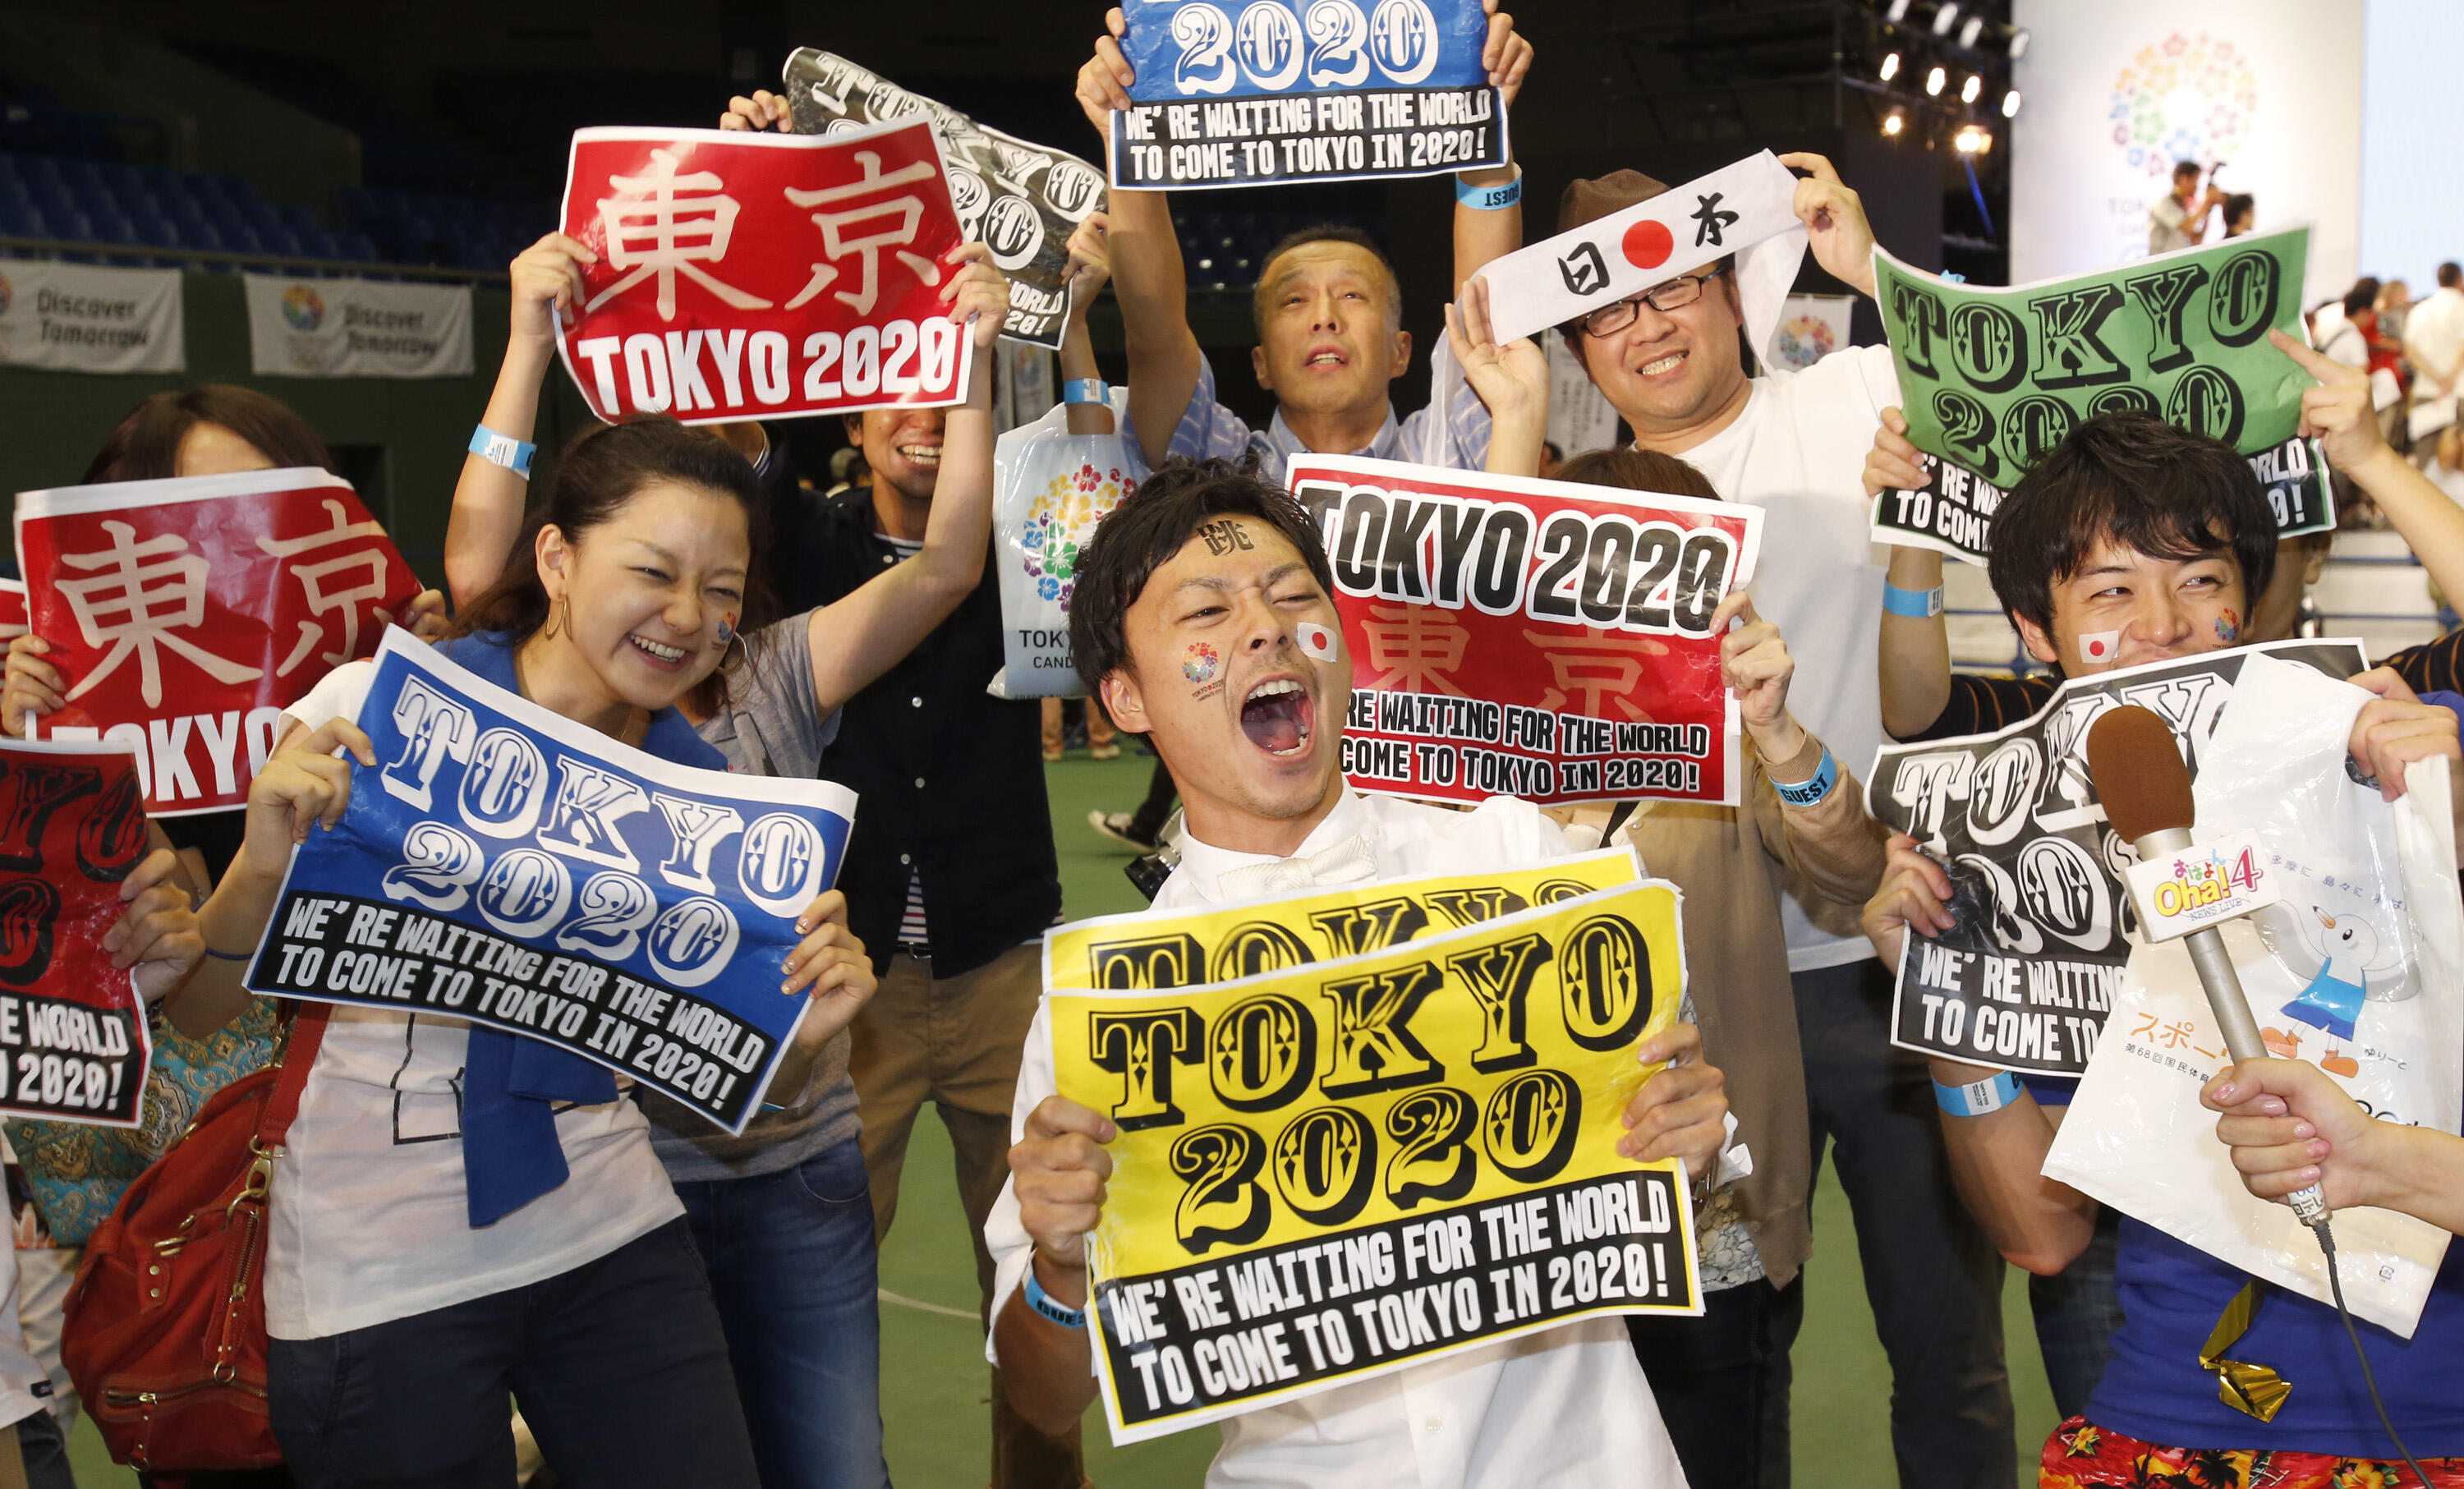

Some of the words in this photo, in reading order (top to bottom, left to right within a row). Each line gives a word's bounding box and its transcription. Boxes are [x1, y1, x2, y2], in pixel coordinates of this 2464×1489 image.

[1171, 1, 1439, 95] 2020
[1203, 97, 1312, 136] WAITING
[1317, 95, 1364, 131] FOR
[1367, 92, 1414, 128] THE
[1418, 88, 1492, 126] WORLD
[1129, 145, 1163, 181] TO
[1170, 142, 1236, 179] COME
[1241, 140, 1276, 175] TO
[1280, 136, 1364, 172] TOKYO
[1371, 133, 1404, 169] IN
[1410, 128, 1486, 166] 2020!
[585, 148, 942, 323] 東京
[37, 289, 137, 319] Discover
[41, 318, 149, 350] Tomorrow
[1891, 249, 2282, 394] TOKYO
[577, 328, 791, 416] TOKYO
[802, 315, 959, 402] 2020
[1197, 520, 1255, 556] 跳
[1895, 490, 1932, 529] TO
[1296, 483, 1533, 614] TOKYO
[1531, 514, 1730, 634] 2020
[54, 499, 396, 708] 東京
[1360, 604, 1670, 726] 東京
[1380, 693, 1498, 742] WAITING
[1506, 708, 1555, 752] FOR
[1561, 716, 1611, 756] THE
[1617, 723, 1708, 757] WORLD
[379, 673, 825, 918] TOKYO
[1340, 737, 1409, 779] COME
[1418, 745, 1455, 784] TO
[1464, 751, 1553, 795] TOKYO
[1561, 762, 1598, 793] IN
[1607, 760, 1699, 794] 2020!
[1780, 773, 1828, 803] GUEST
[2173, 848, 2226, 881] おはよん
[2269, 854, 2314, 878] 多摩に
[382, 821, 740, 987] 2020
[2190, 905, 2218, 921] NEWS
[2219, 897, 2243, 913] LIVE
[276, 944, 324, 987] TO
[327, 951, 424, 1000] COME
[425, 965, 476, 1006] TO
[476, 972, 590, 1039] TOKYO
[585, 1012, 638, 1060] IN
[631, 1033, 738, 1111] 2020!
[395, 914, 542, 981] WAITING
[541, 954, 610, 1002] FOR
[609, 971, 673, 1025] THE
[668, 998, 766, 1075] WORLD
[1089, 913, 1653, 1133] TOKYO
[25, 1000, 130, 1057] WORLD
[1920, 994, 1966, 1047] TO
[1972, 1004, 2062, 1062] COME
[2065, 1016, 2098, 1064] TO
[2130, 1011, 2228, 1059] スポー
[2363, 1046, 2409, 1071] ゆりーと
[16, 1051, 123, 1111] 2020!
[1170, 1068, 1583, 1256] 2020
[1227, 1232, 1395, 1321] WAITING
[1401, 1214, 1478, 1281] FOR
[1479, 1193, 1552, 1257] THE
[1555, 1179, 1673, 1242] WORLD
[1130, 1344, 1195, 1413] TO
[1193, 1321, 1299, 1396] COME
[1296, 1307, 1355, 1368] TO
[1354, 1275, 1483, 1352] TOKYO
[1488, 1262, 1542, 1324] IN
[1547, 1243, 1670, 1312] 2020!
